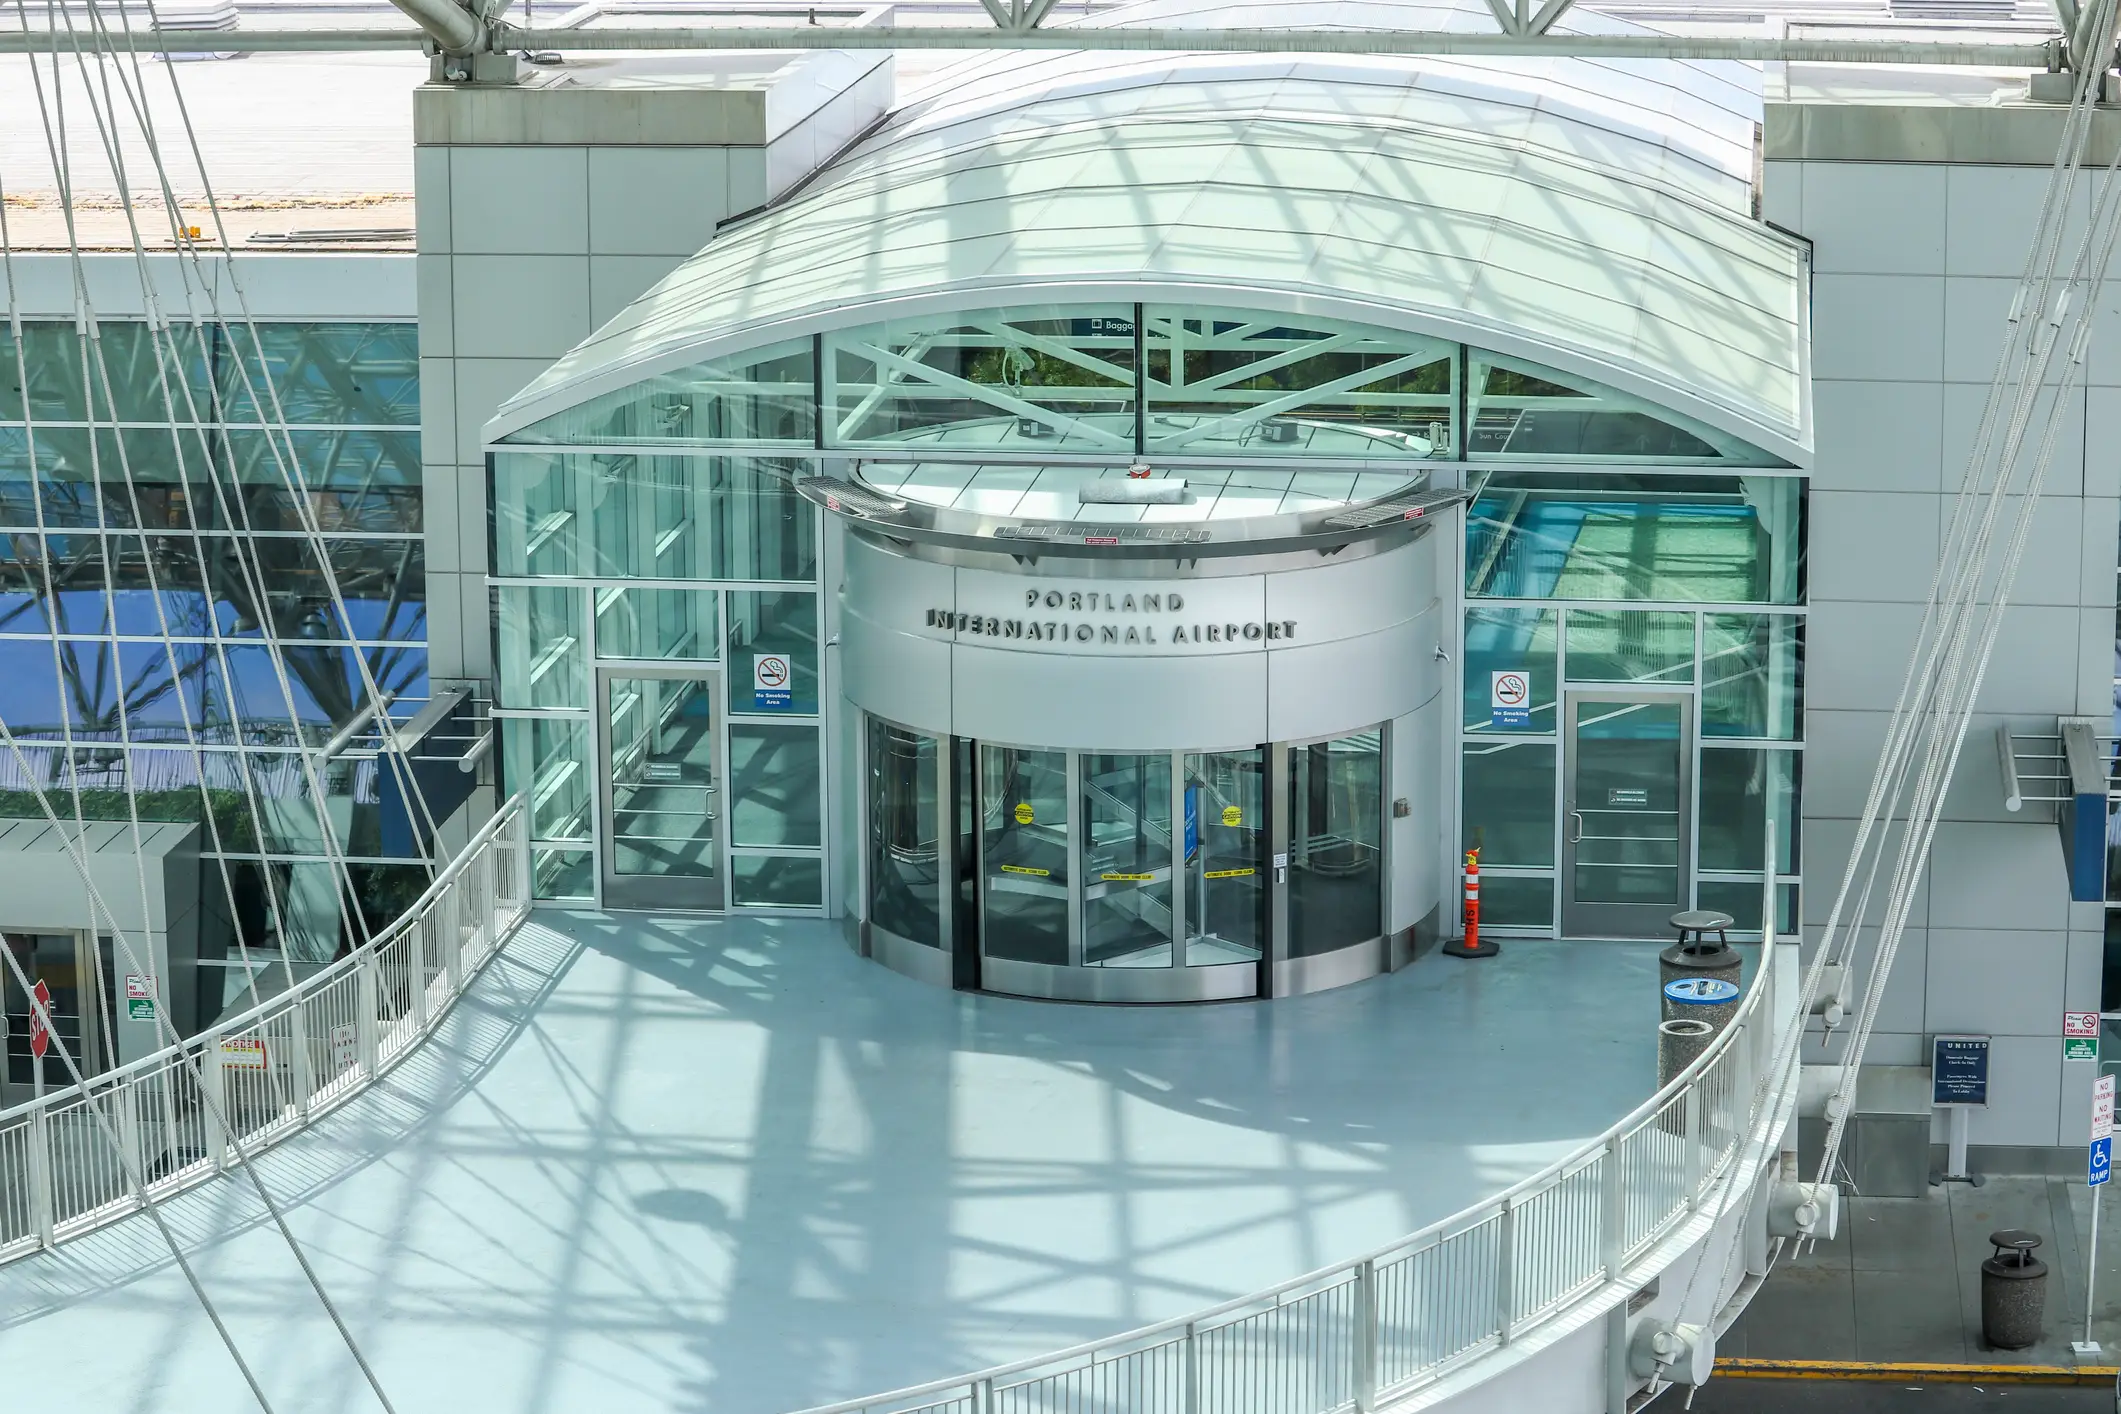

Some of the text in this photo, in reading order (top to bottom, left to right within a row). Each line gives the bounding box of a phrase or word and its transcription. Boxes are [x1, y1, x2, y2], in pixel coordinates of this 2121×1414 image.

[1106, 321, 1134, 332] Bagga
[1025, 589, 1185, 613] PORTLAND
[925, 608, 1298, 644] INTERNATIONAL AIRPORT
[1503, 710, 1529, 718] Smoking
[2099, 1082, 2109, 1091] NO
[2094, 1091, 2113, 1101] PARKING
[2098, 1104, 2108, 1113] NO
[2094, 1114, 2112, 1123] WAITING
[2090, 1169, 2109, 1183] RAMP
